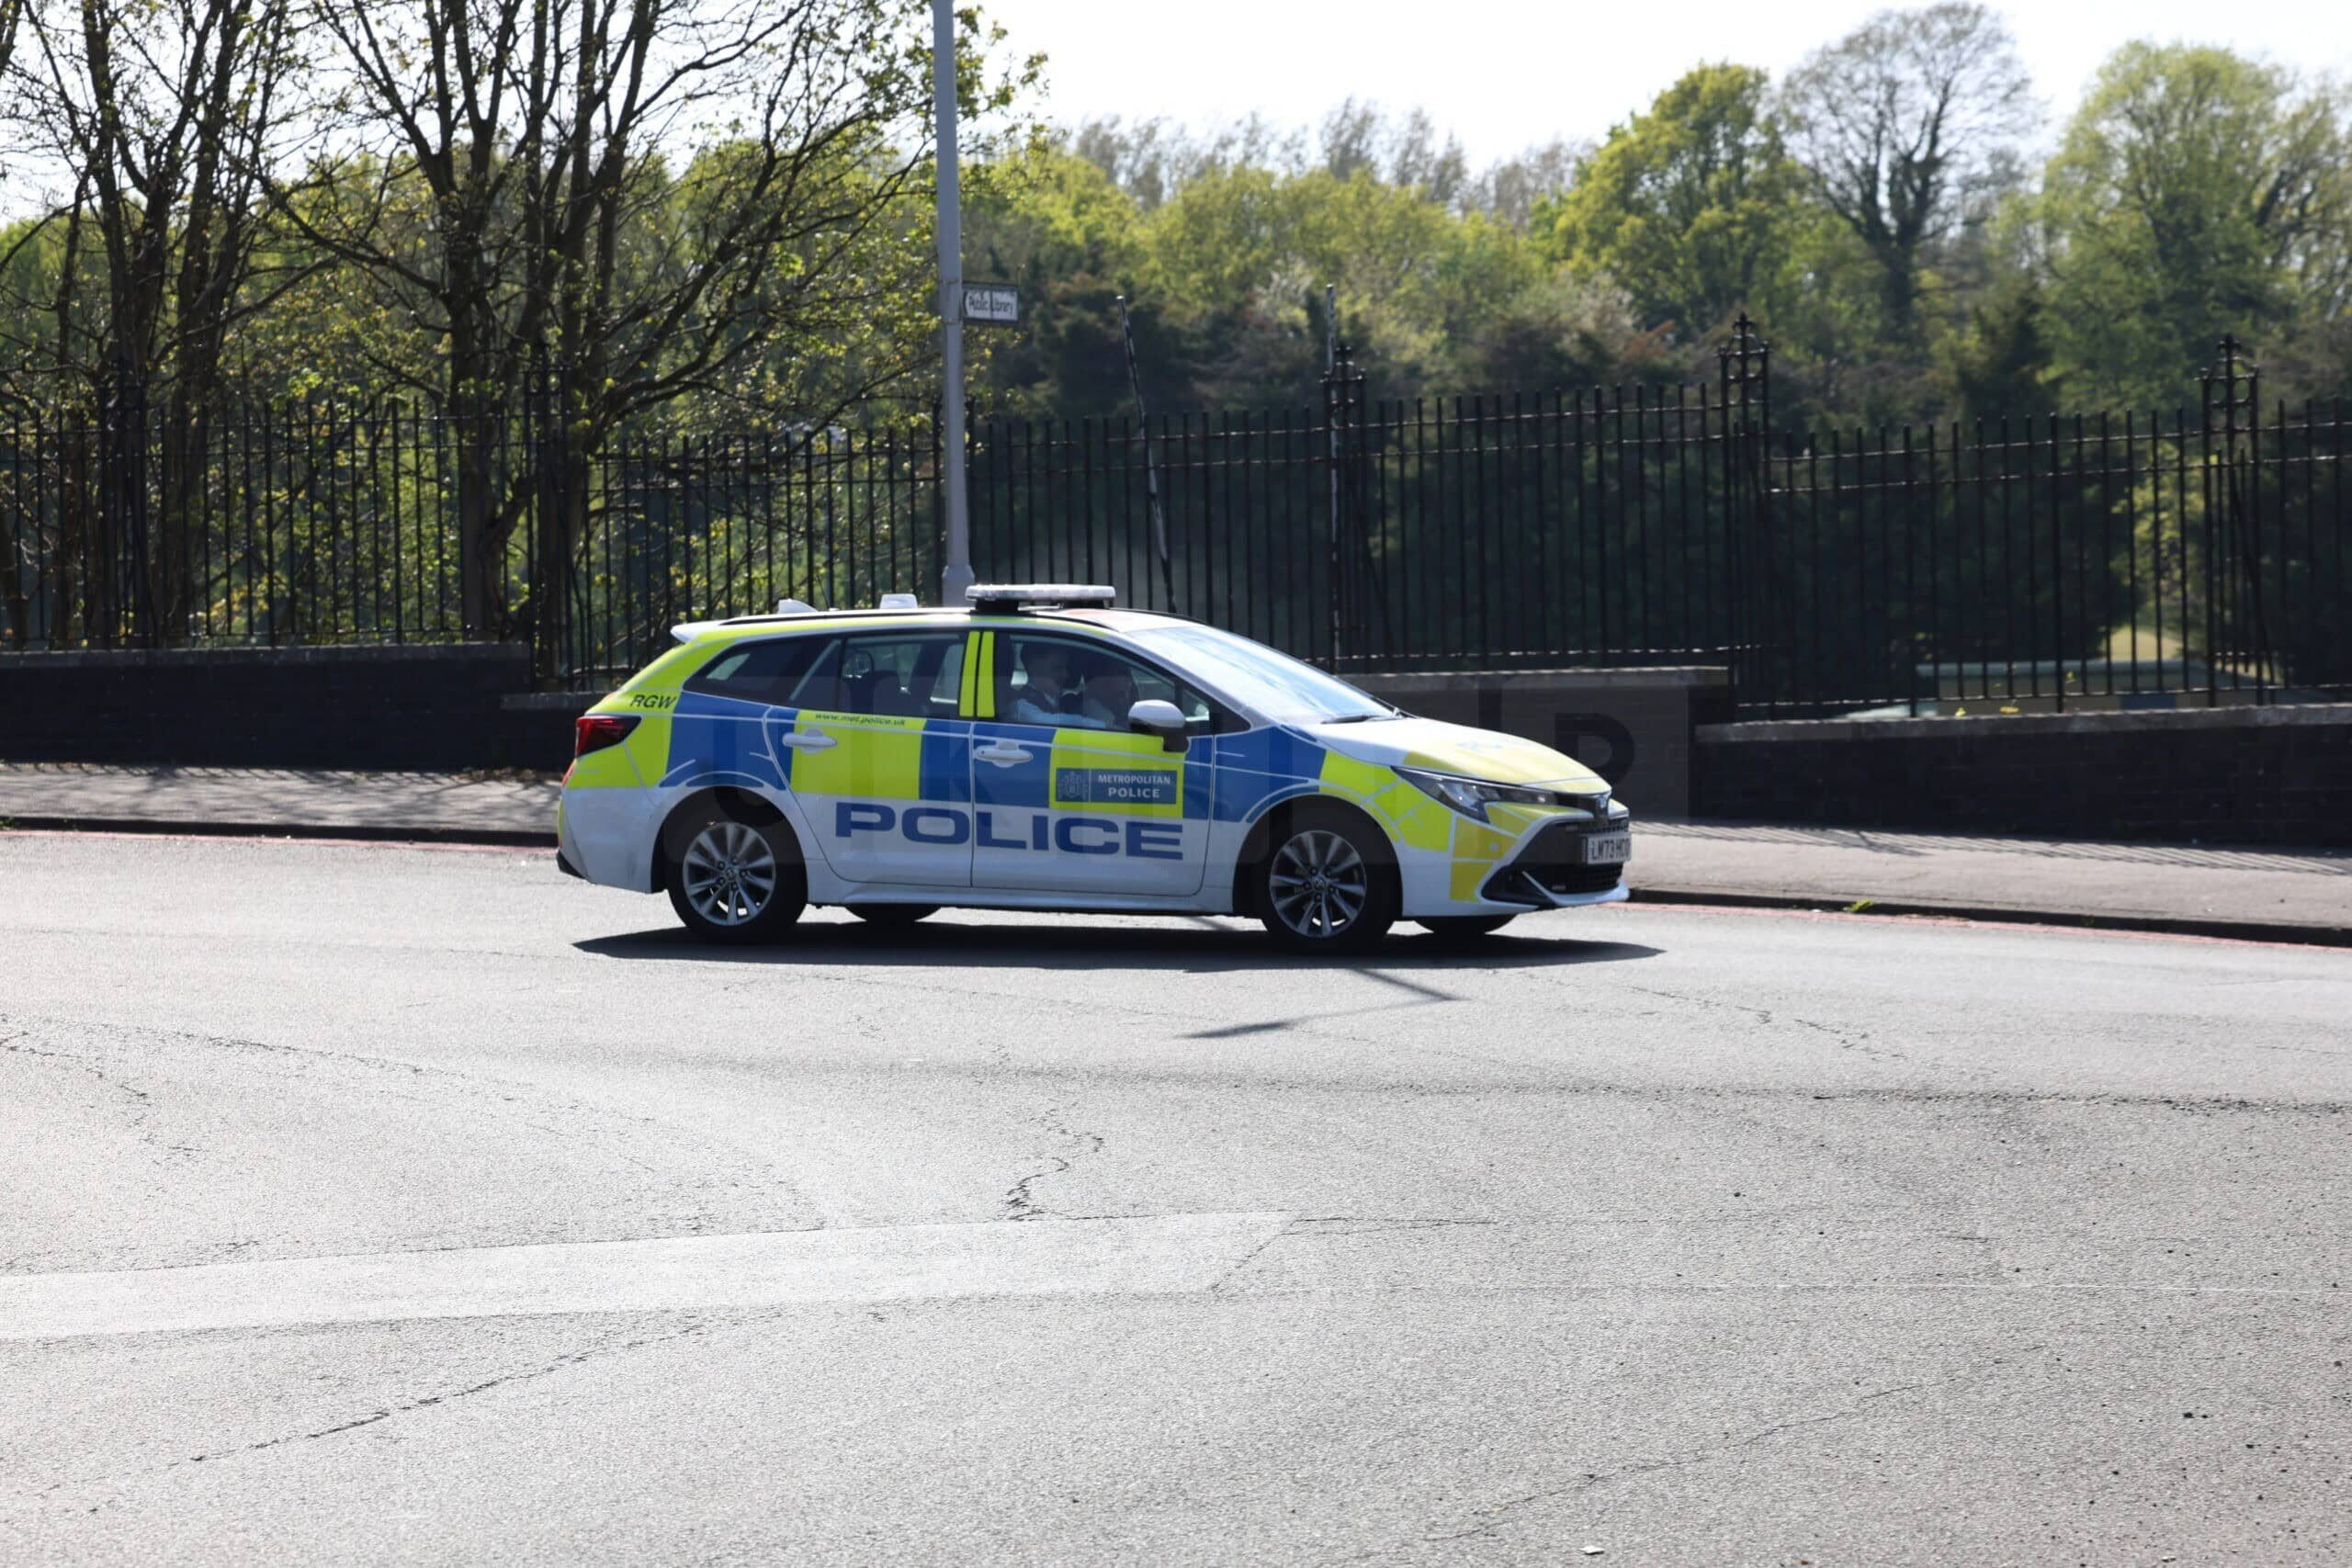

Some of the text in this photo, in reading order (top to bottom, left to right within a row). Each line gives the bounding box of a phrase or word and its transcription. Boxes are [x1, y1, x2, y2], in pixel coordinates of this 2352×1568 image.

[629, 694, 677, 709] RGW
[1098, 773, 1171, 785] METROPOLITAN
[1108, 787, 1160, 798] POLICE
[835, 802, 1182, 861] POLICE
